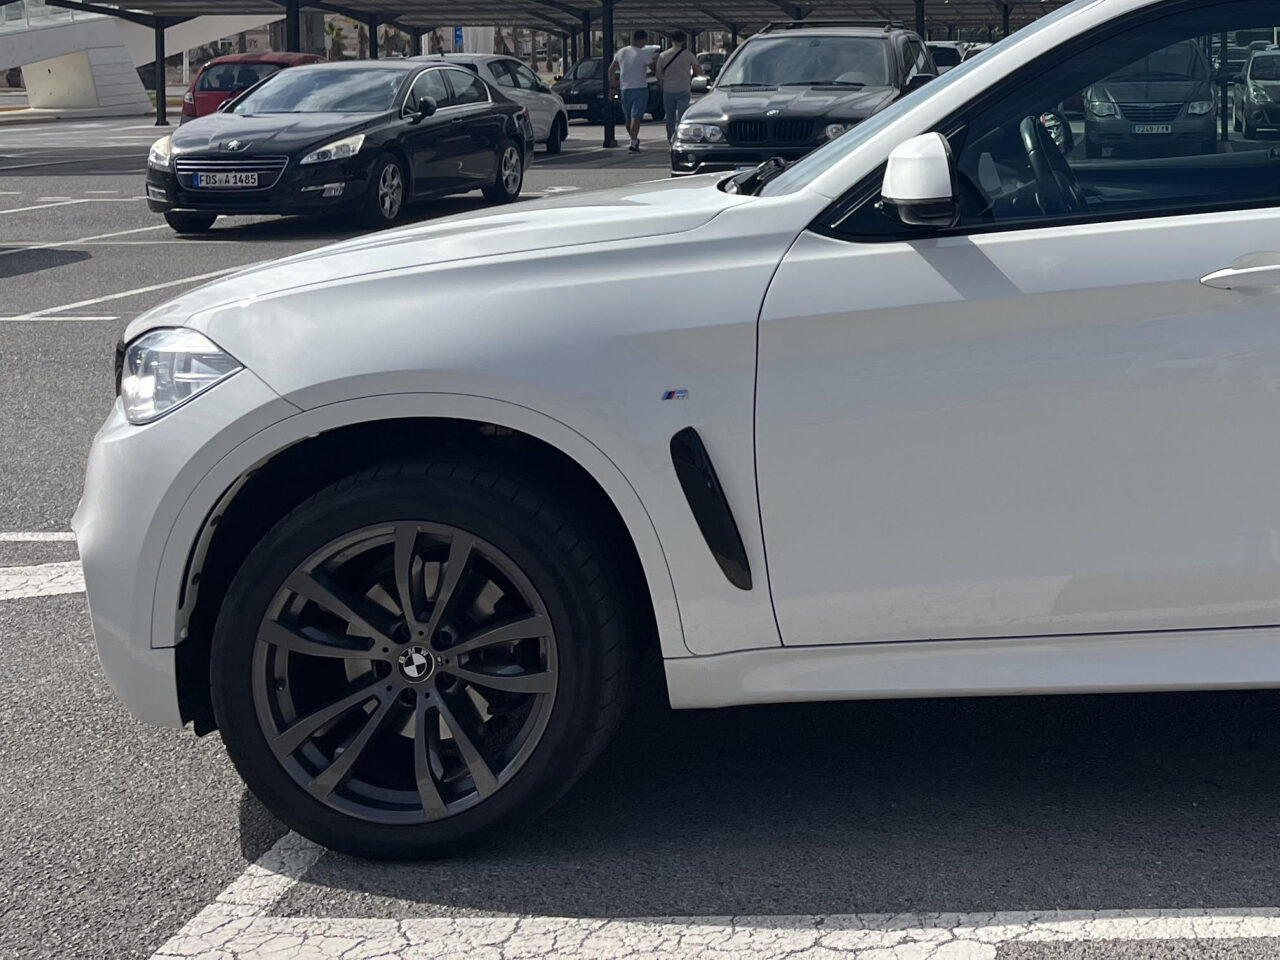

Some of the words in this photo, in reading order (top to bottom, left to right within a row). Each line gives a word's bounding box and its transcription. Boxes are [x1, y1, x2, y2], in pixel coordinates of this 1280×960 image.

[199, 174, 217, 185] FDS
[224, 174, 230, 185] A
[232, 174, 257, 185] 1485
